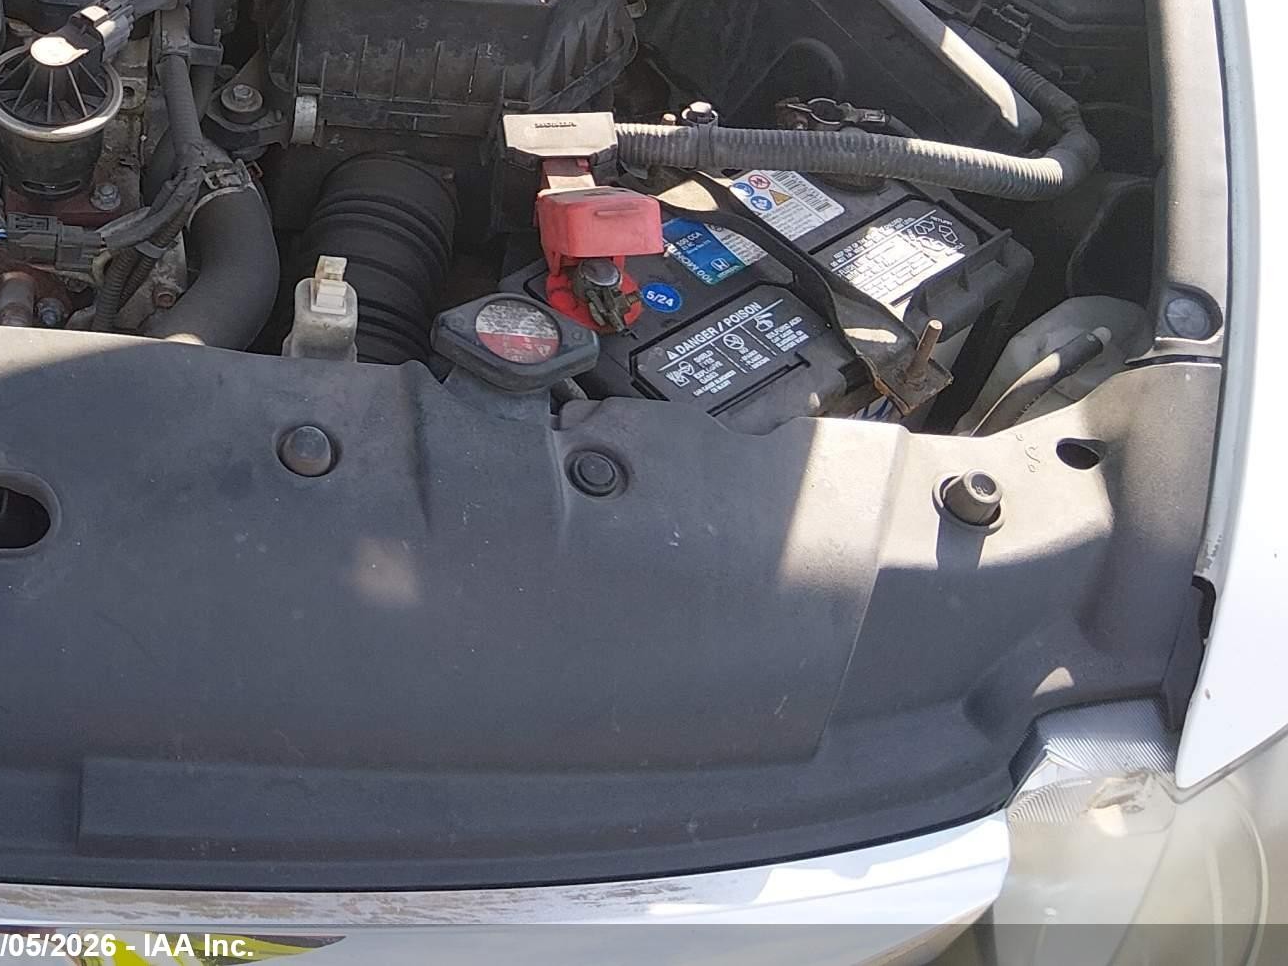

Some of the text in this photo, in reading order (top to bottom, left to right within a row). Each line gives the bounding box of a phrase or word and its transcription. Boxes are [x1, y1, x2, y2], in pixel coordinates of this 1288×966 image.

[646, 290, 674, 307] 5/24
[675, 326, 721, 355] DANGER
[723, 301, 763, 328] POISON
